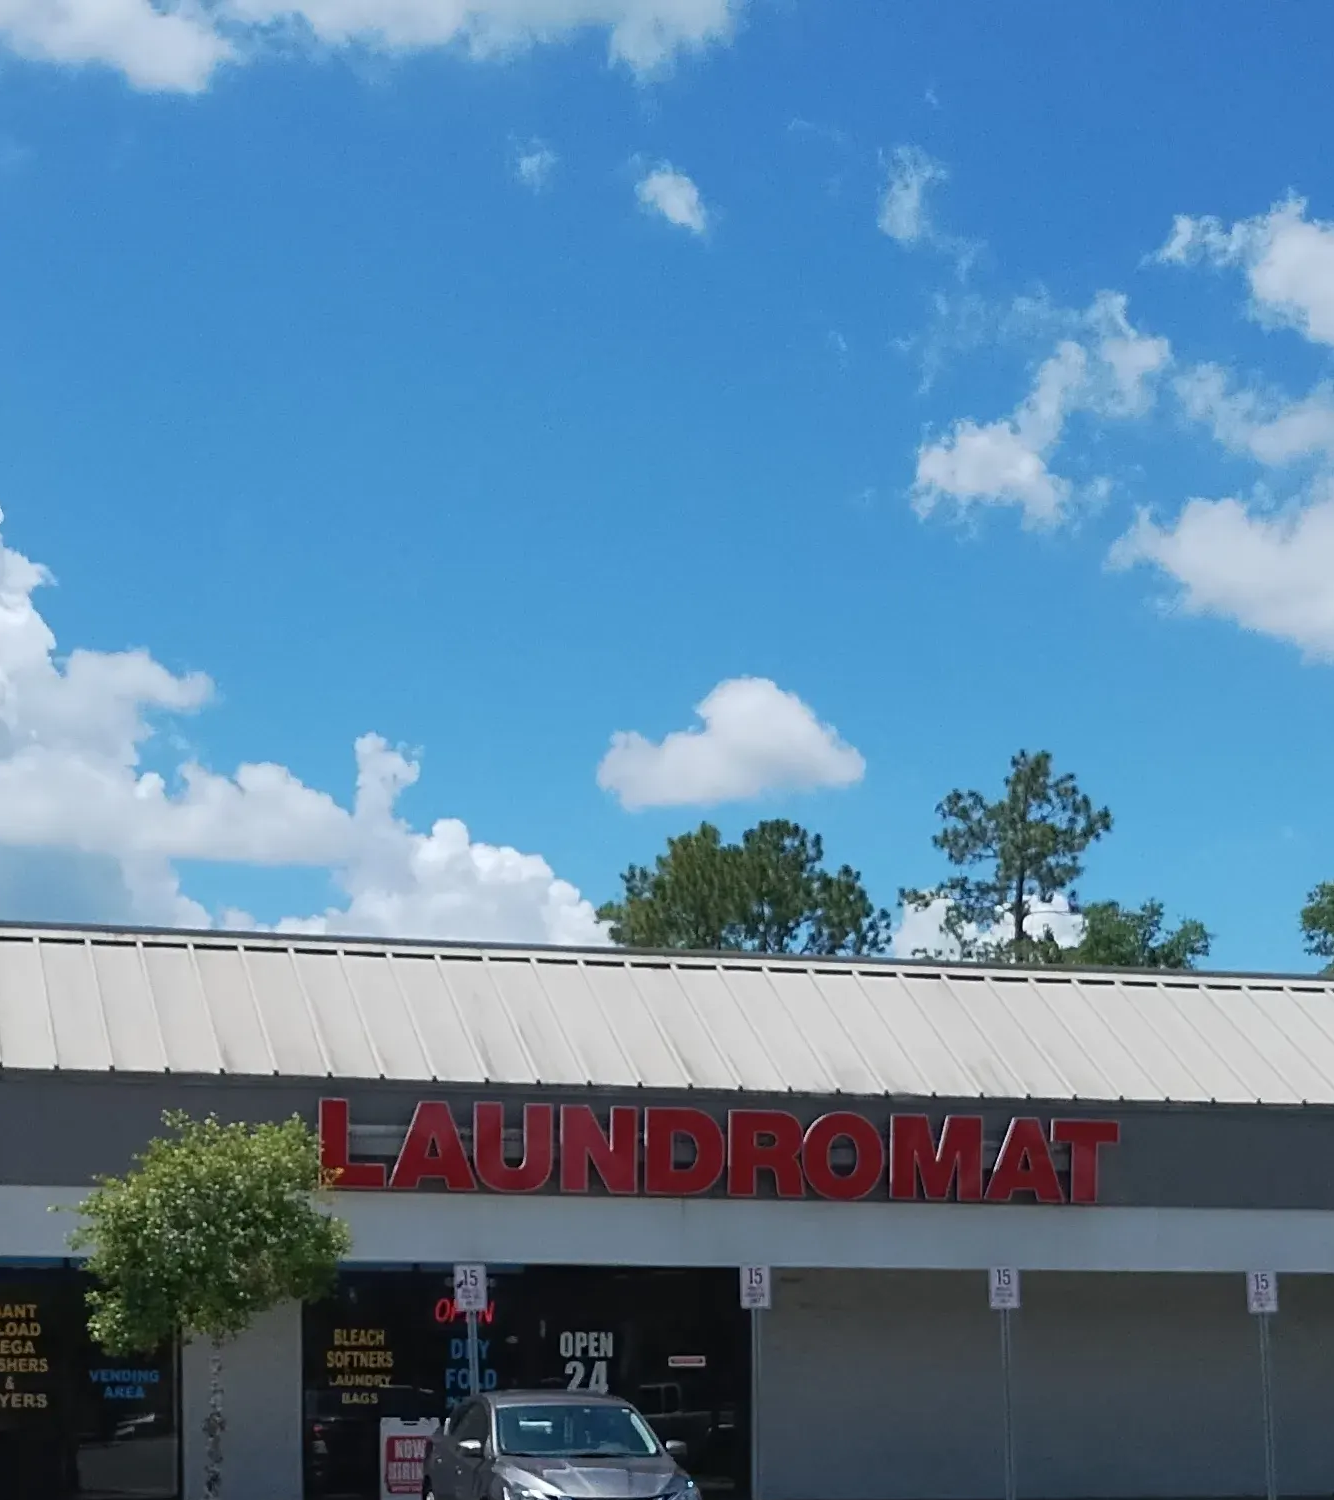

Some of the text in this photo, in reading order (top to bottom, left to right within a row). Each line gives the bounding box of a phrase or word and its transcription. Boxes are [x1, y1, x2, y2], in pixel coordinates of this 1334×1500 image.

[318, 1097, 1120, 1205] LAUNDROMAT
[462, 1269, 478, 1286] 15
[748, 1267, 763, 1284] 15
[996, 1268, 1011, 1285] 15
[1254, 1273, 1269, 1290] 15
[333, 1328, 385, 1346] BLEACH
[559, 1331, 614, 1358] OPEN
[326, 1350, 395, 1368] SOFTNERS
[3, 1375, 15, 1390] &
[88, 1369, 161, 1384] VENDING
[329, 1374, 392, 1388] LAUNDRY
[564, 1361, 610, 1395] 24
[103, 1385, 146, 1399] AREA
[341, 1391, 379, 1405] BAGS
